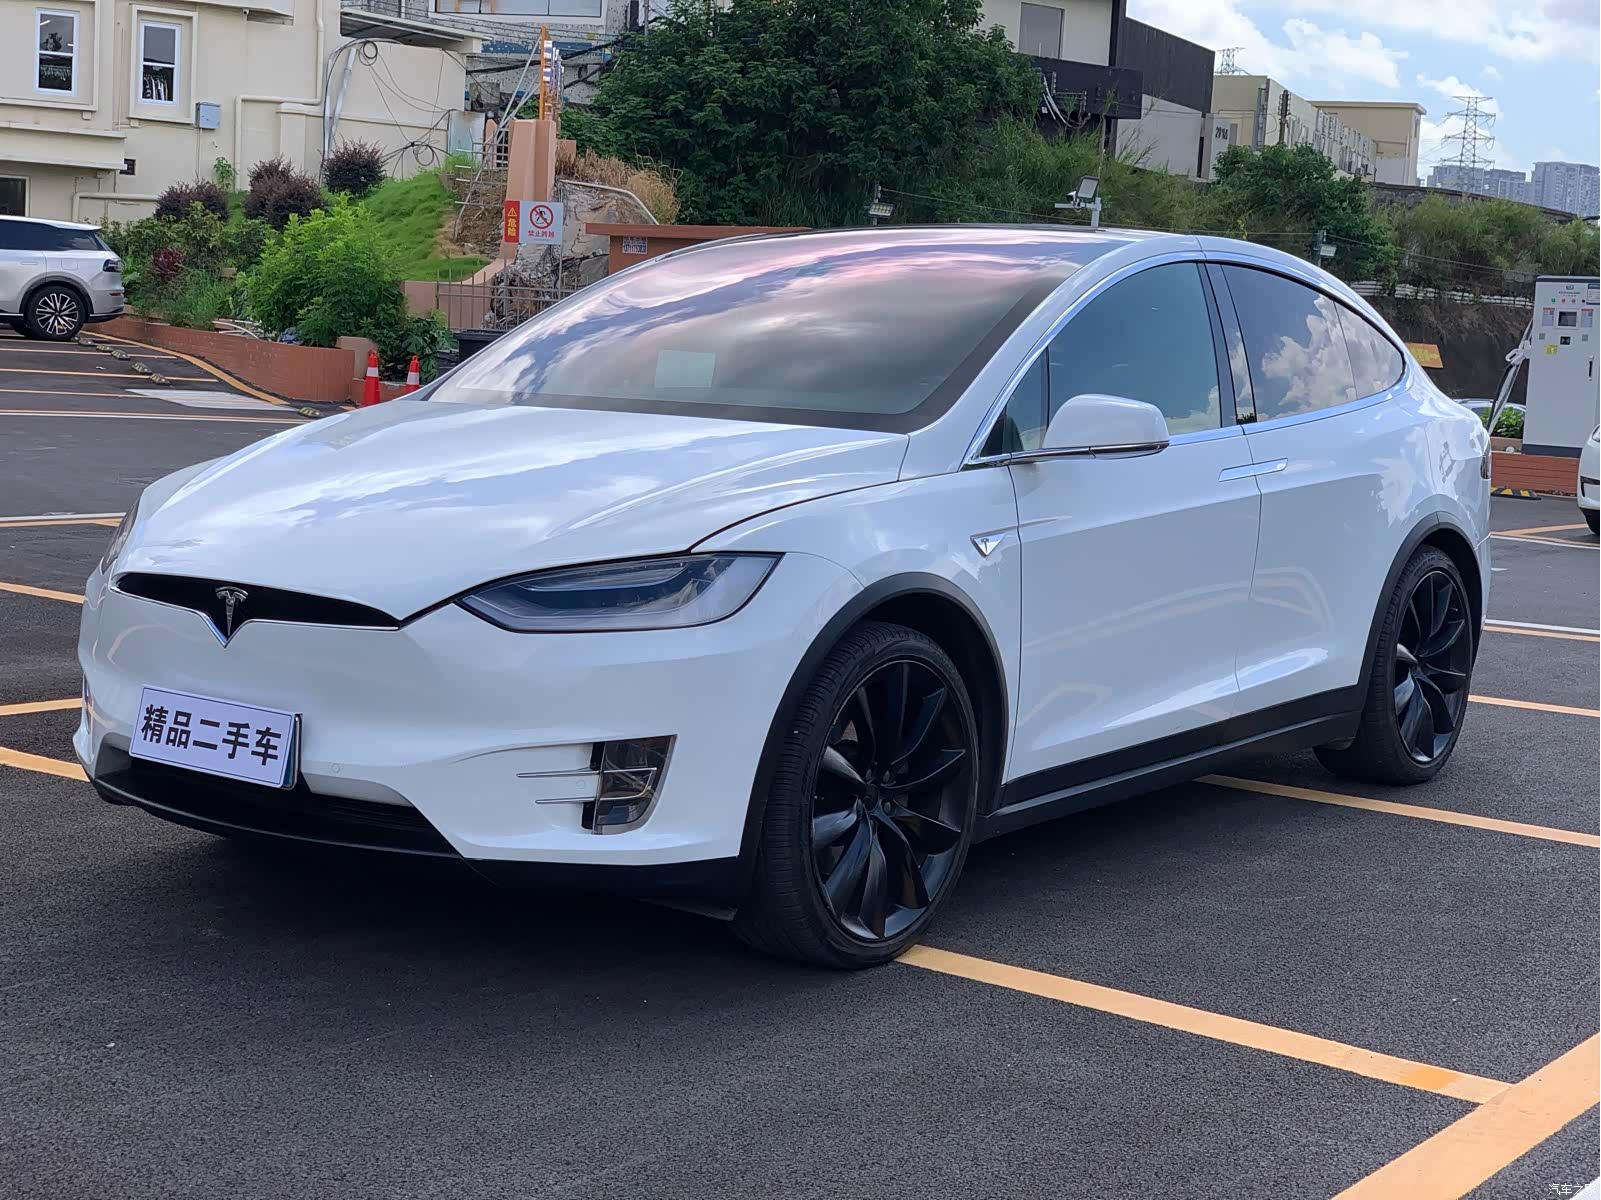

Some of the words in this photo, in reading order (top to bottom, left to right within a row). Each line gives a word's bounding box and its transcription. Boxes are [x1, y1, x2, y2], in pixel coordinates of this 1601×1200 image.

[141, 704, 282, 766] 精品二手车
